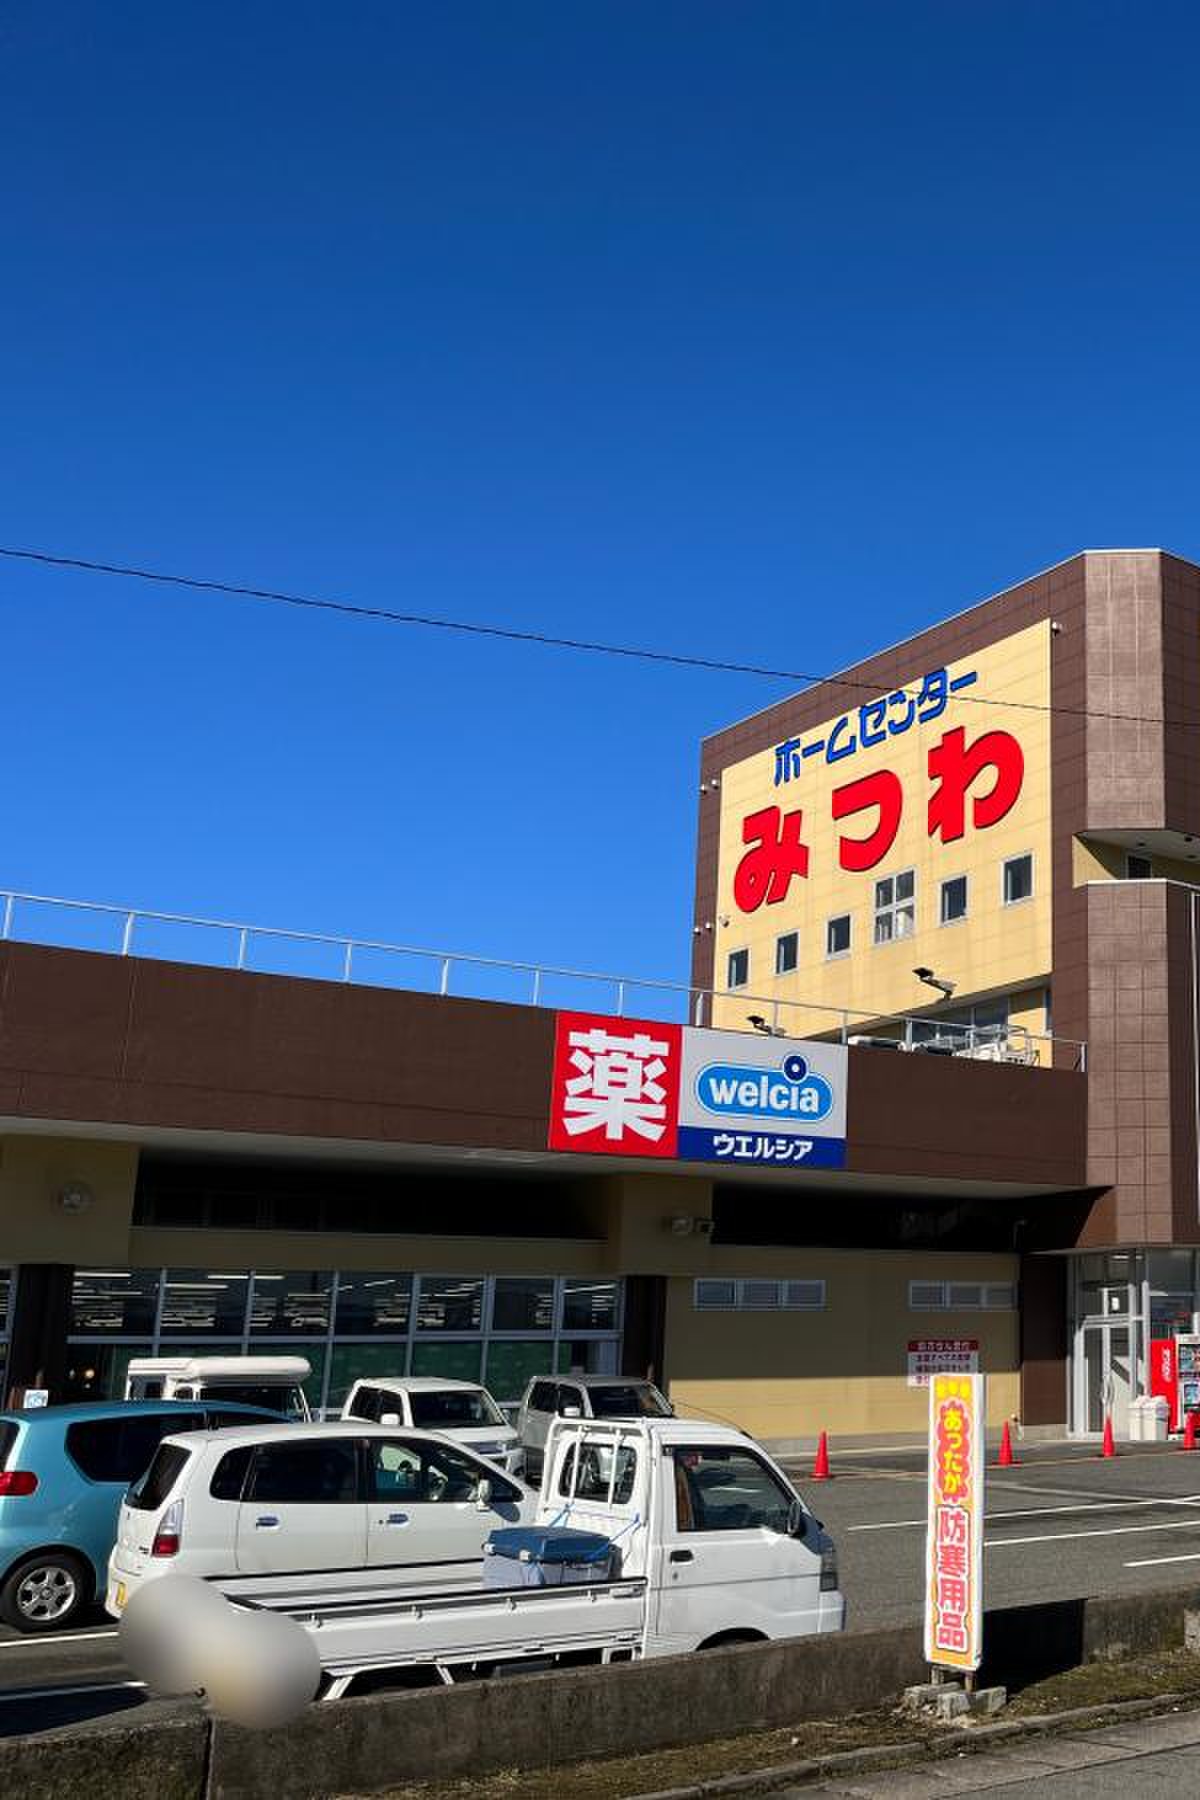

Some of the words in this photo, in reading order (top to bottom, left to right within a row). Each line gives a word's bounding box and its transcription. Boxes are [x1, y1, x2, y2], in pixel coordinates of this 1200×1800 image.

[774, 667, 978, 786] ホームセンター
[733, 726, 1025, 912] みつわ
[562, 1028, 670, 1142] 薬
[708, 1064, 820, 1114] welcia
[713, 1133, 813, 1160] ウエルシア
[938, 1510, 966, 1650] 防寒用品
